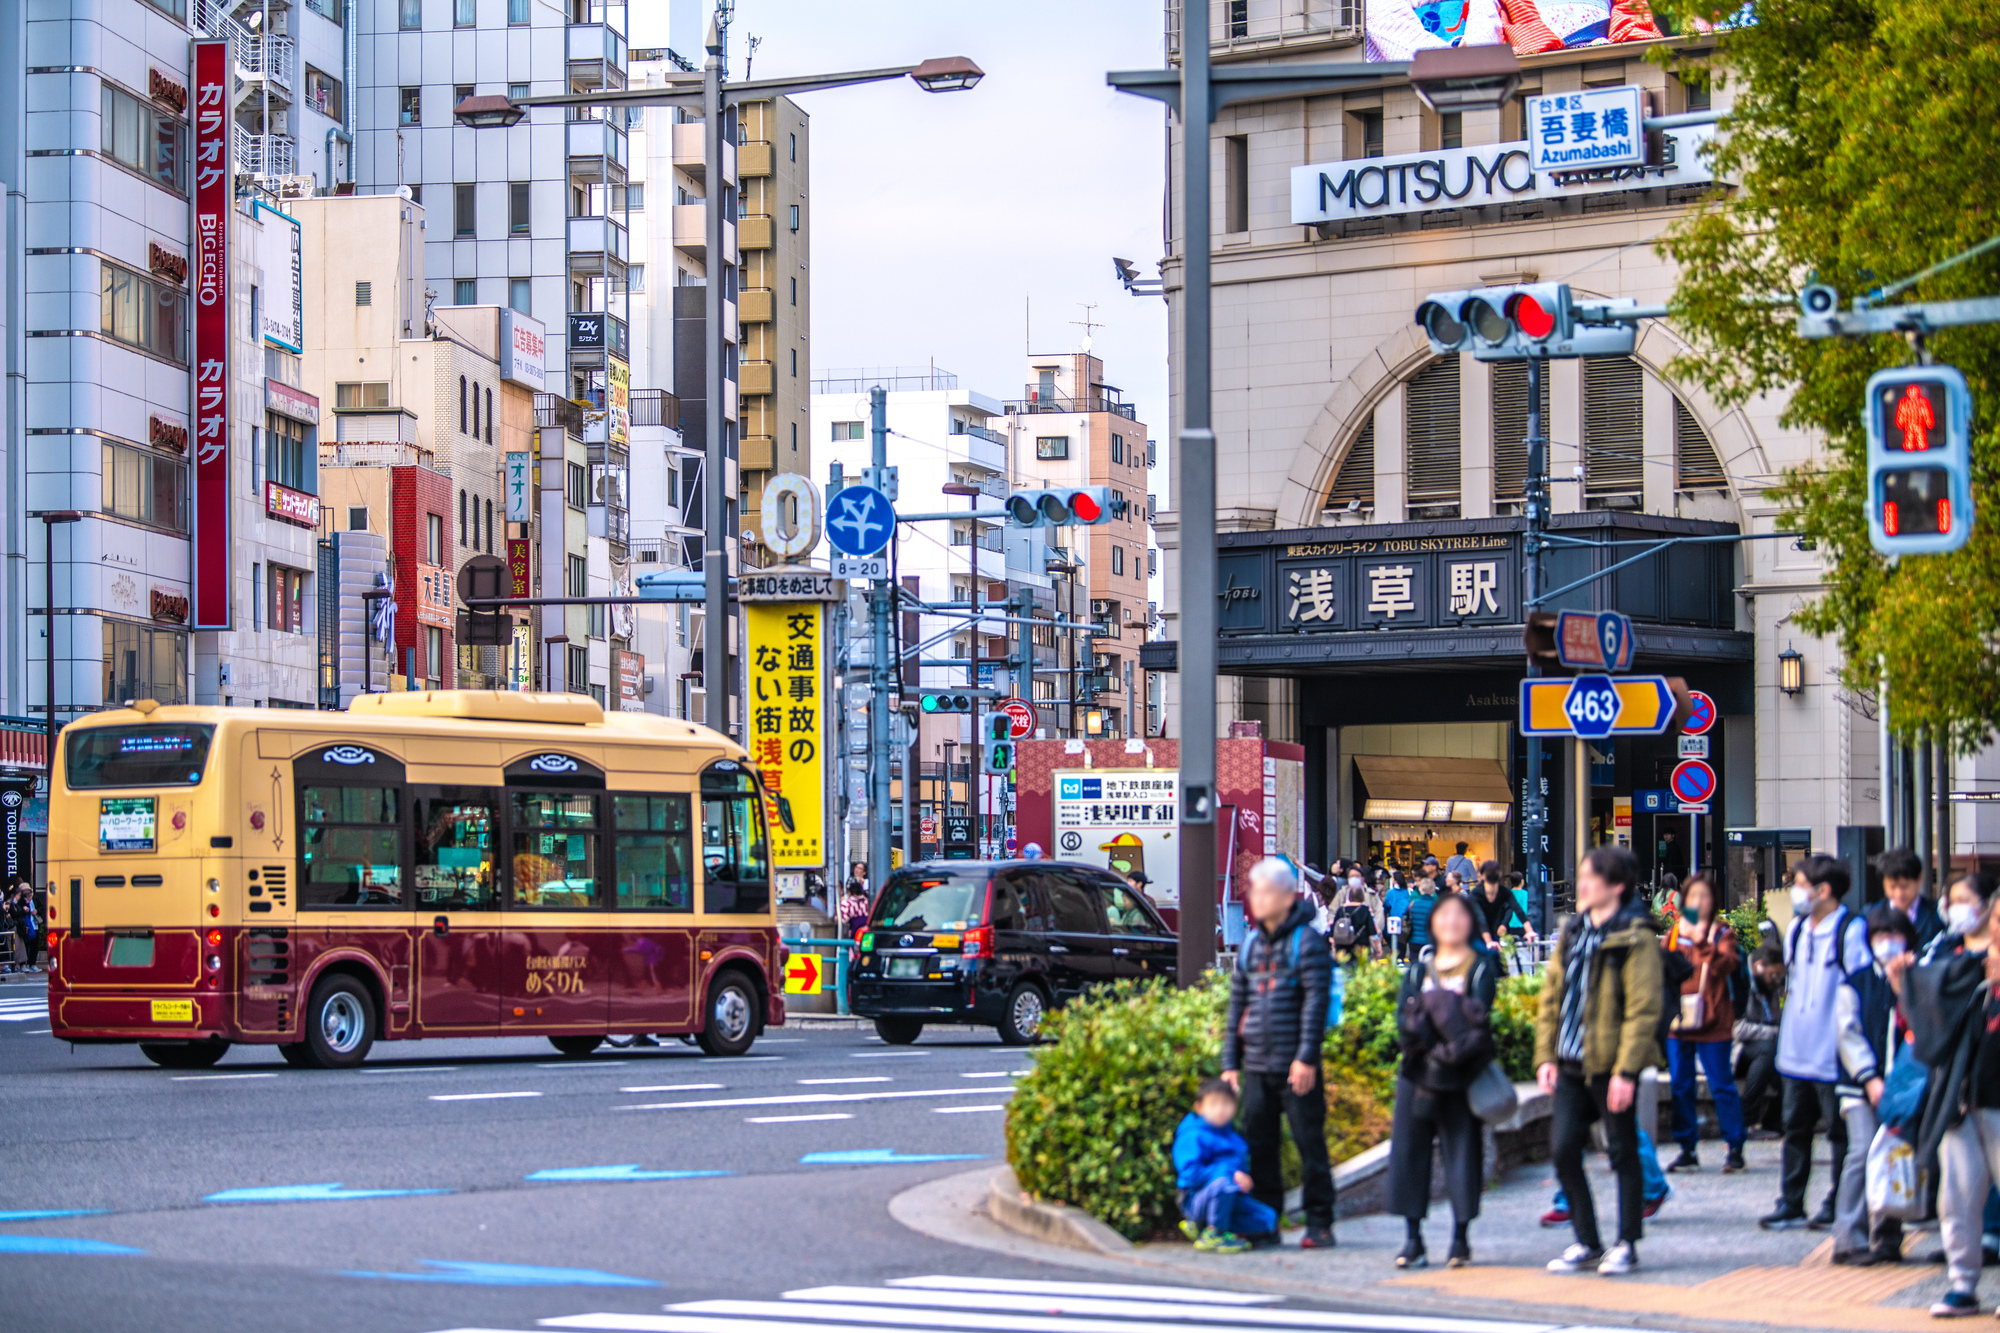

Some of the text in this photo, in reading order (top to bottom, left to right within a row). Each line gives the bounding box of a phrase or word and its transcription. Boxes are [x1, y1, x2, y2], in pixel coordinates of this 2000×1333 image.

[1539, 95, 1582, 114] 台東区
[198, 83, 224, 189] カラオケ
[1540, 108, 1629, 145] 吾妻橋
[1541, 139, 1632, 164] Azumabashi
[513, 325, 544, 360] 広告募集中
[579, 321, 598, 335] ZXY
[198, 358, 225, 465] カラオケ
[282, 492, 308, 516] サンドラッグ
[511, 462, 525, 513] オオノ
[1287, 535, 1508, 557] 東武スカイツリーライン TOBU SKYTREE Line
[512, 543, 526, 595] 美容室
[1288, 561, 1498, 622] 浅草駅
[520, 627, 528, 673] ハイパーナイフ
[1604, 620, 1617, 655] 6
[787, 612, 815, 764] 交通事故の
[1466, 693, 1519, 706] Asakus
[1011, 714, 1028, 727] 火栓
[1569, 690, 1614, 722] 463
[1106, 780, 1173, 790] 地下鉄銀座線
[1106, 791, 1147, 799] 浅草駅入口
[7, 809, 18, 878] TOBU HOTEL
[526, 971, 585, 993] めぐりん
